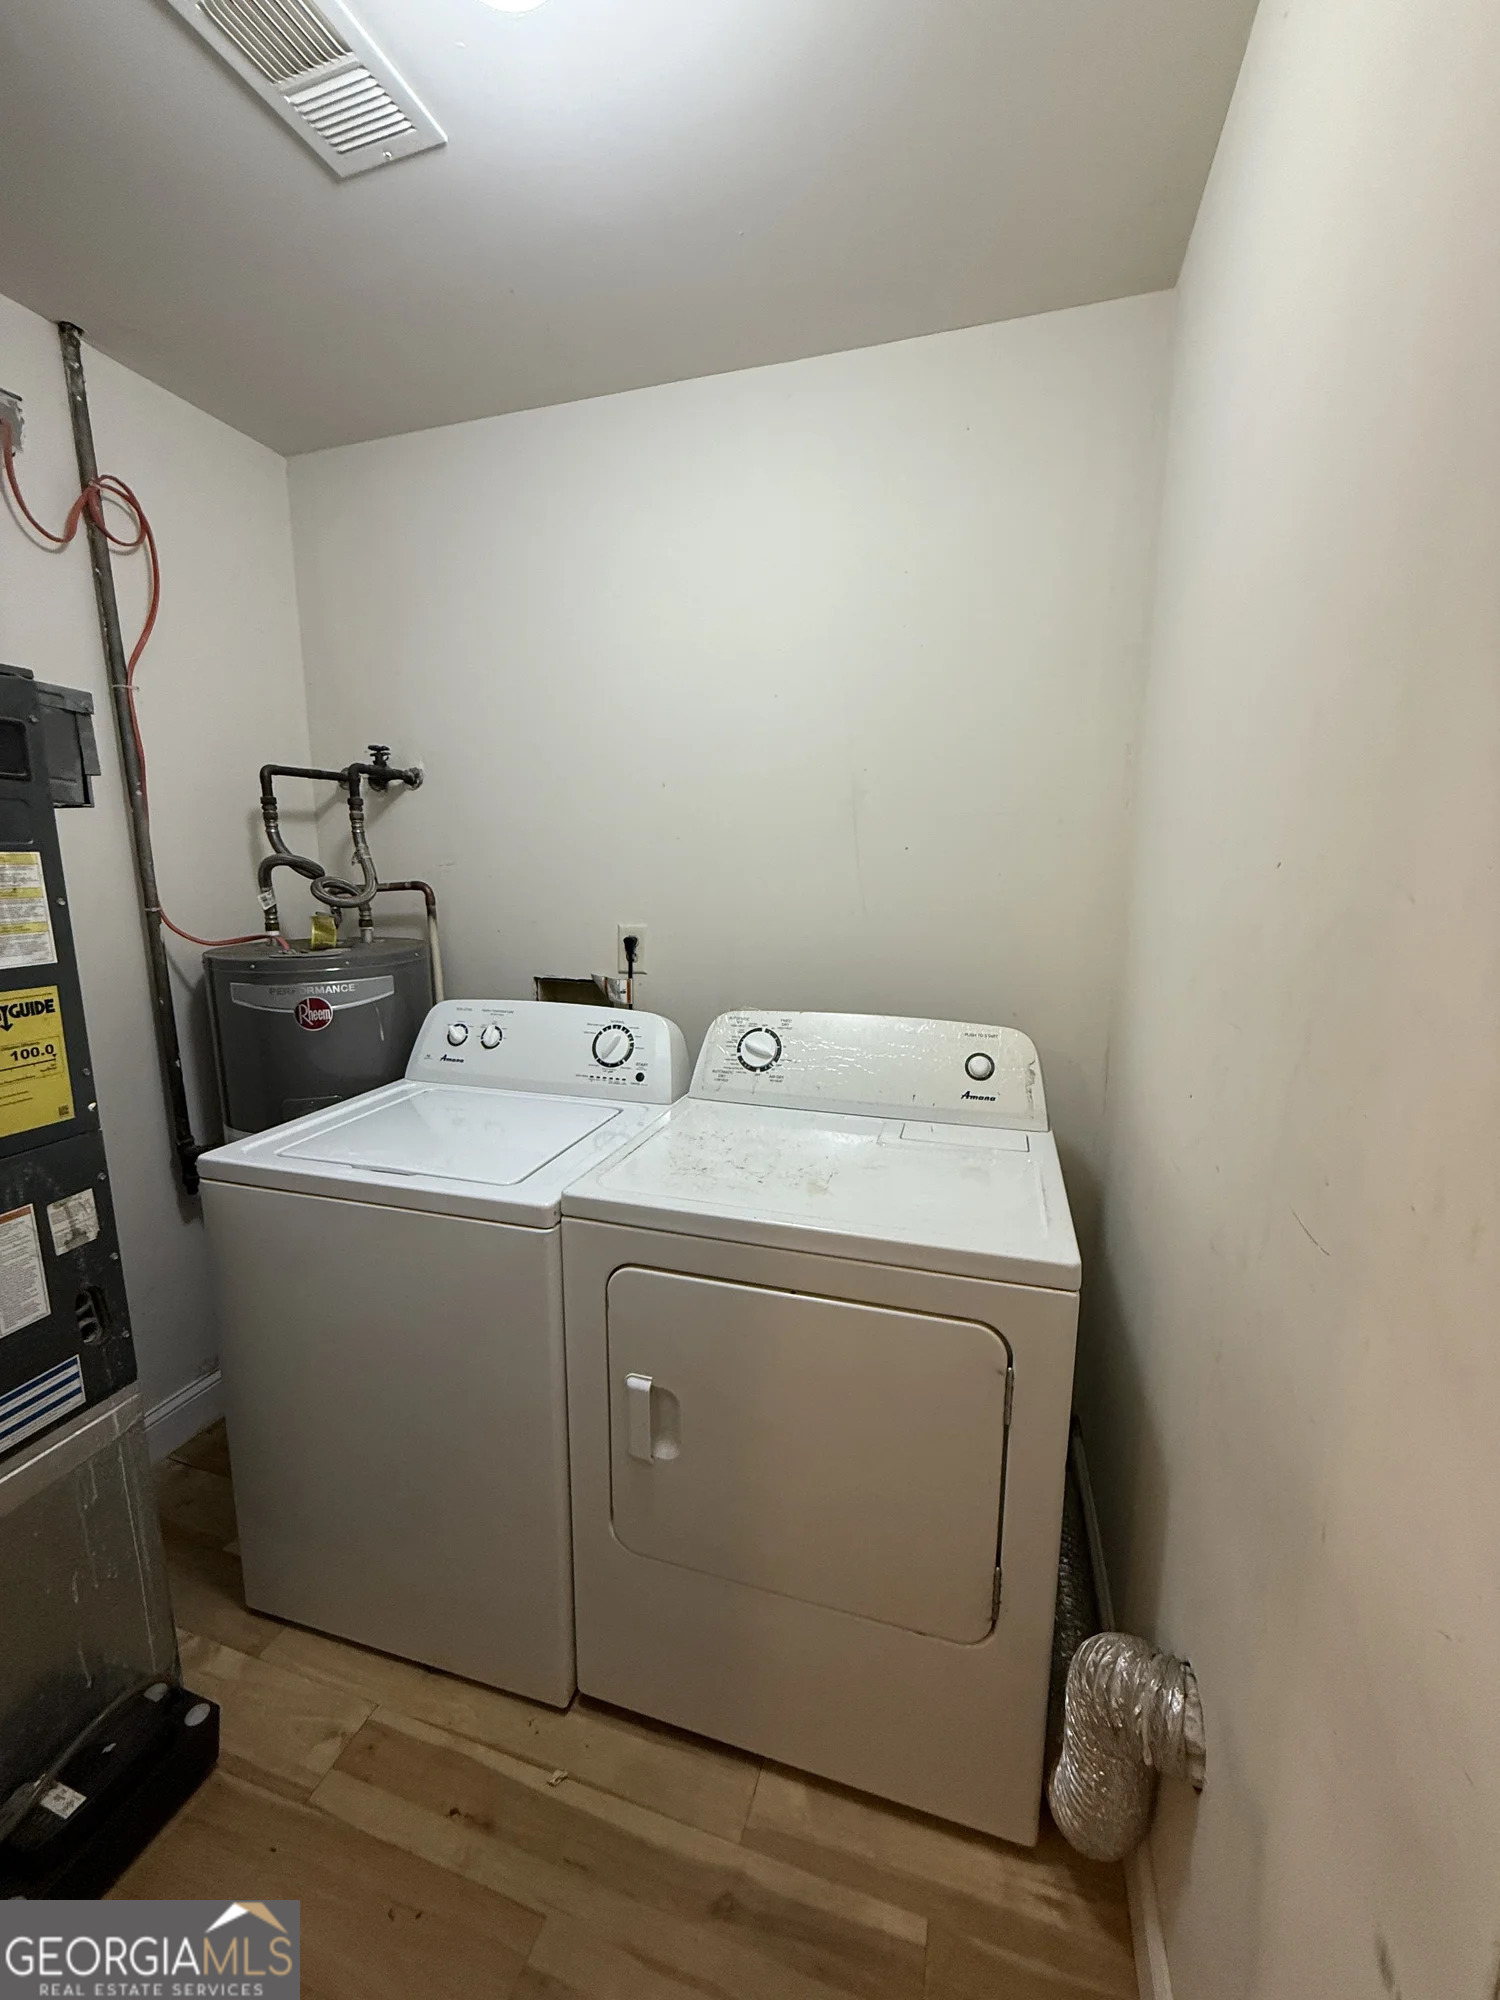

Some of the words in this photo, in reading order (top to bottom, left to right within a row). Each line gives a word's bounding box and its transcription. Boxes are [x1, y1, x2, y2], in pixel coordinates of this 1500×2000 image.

[268, 983, 355, 995] PERFORMANCE
[298, 998, 331, 1025] Rheem
[10, 1044, 55, 1061] 100.0
[440, 1053, 465, 1063] Amana
[961, 1091, 996, 1102] Amana
